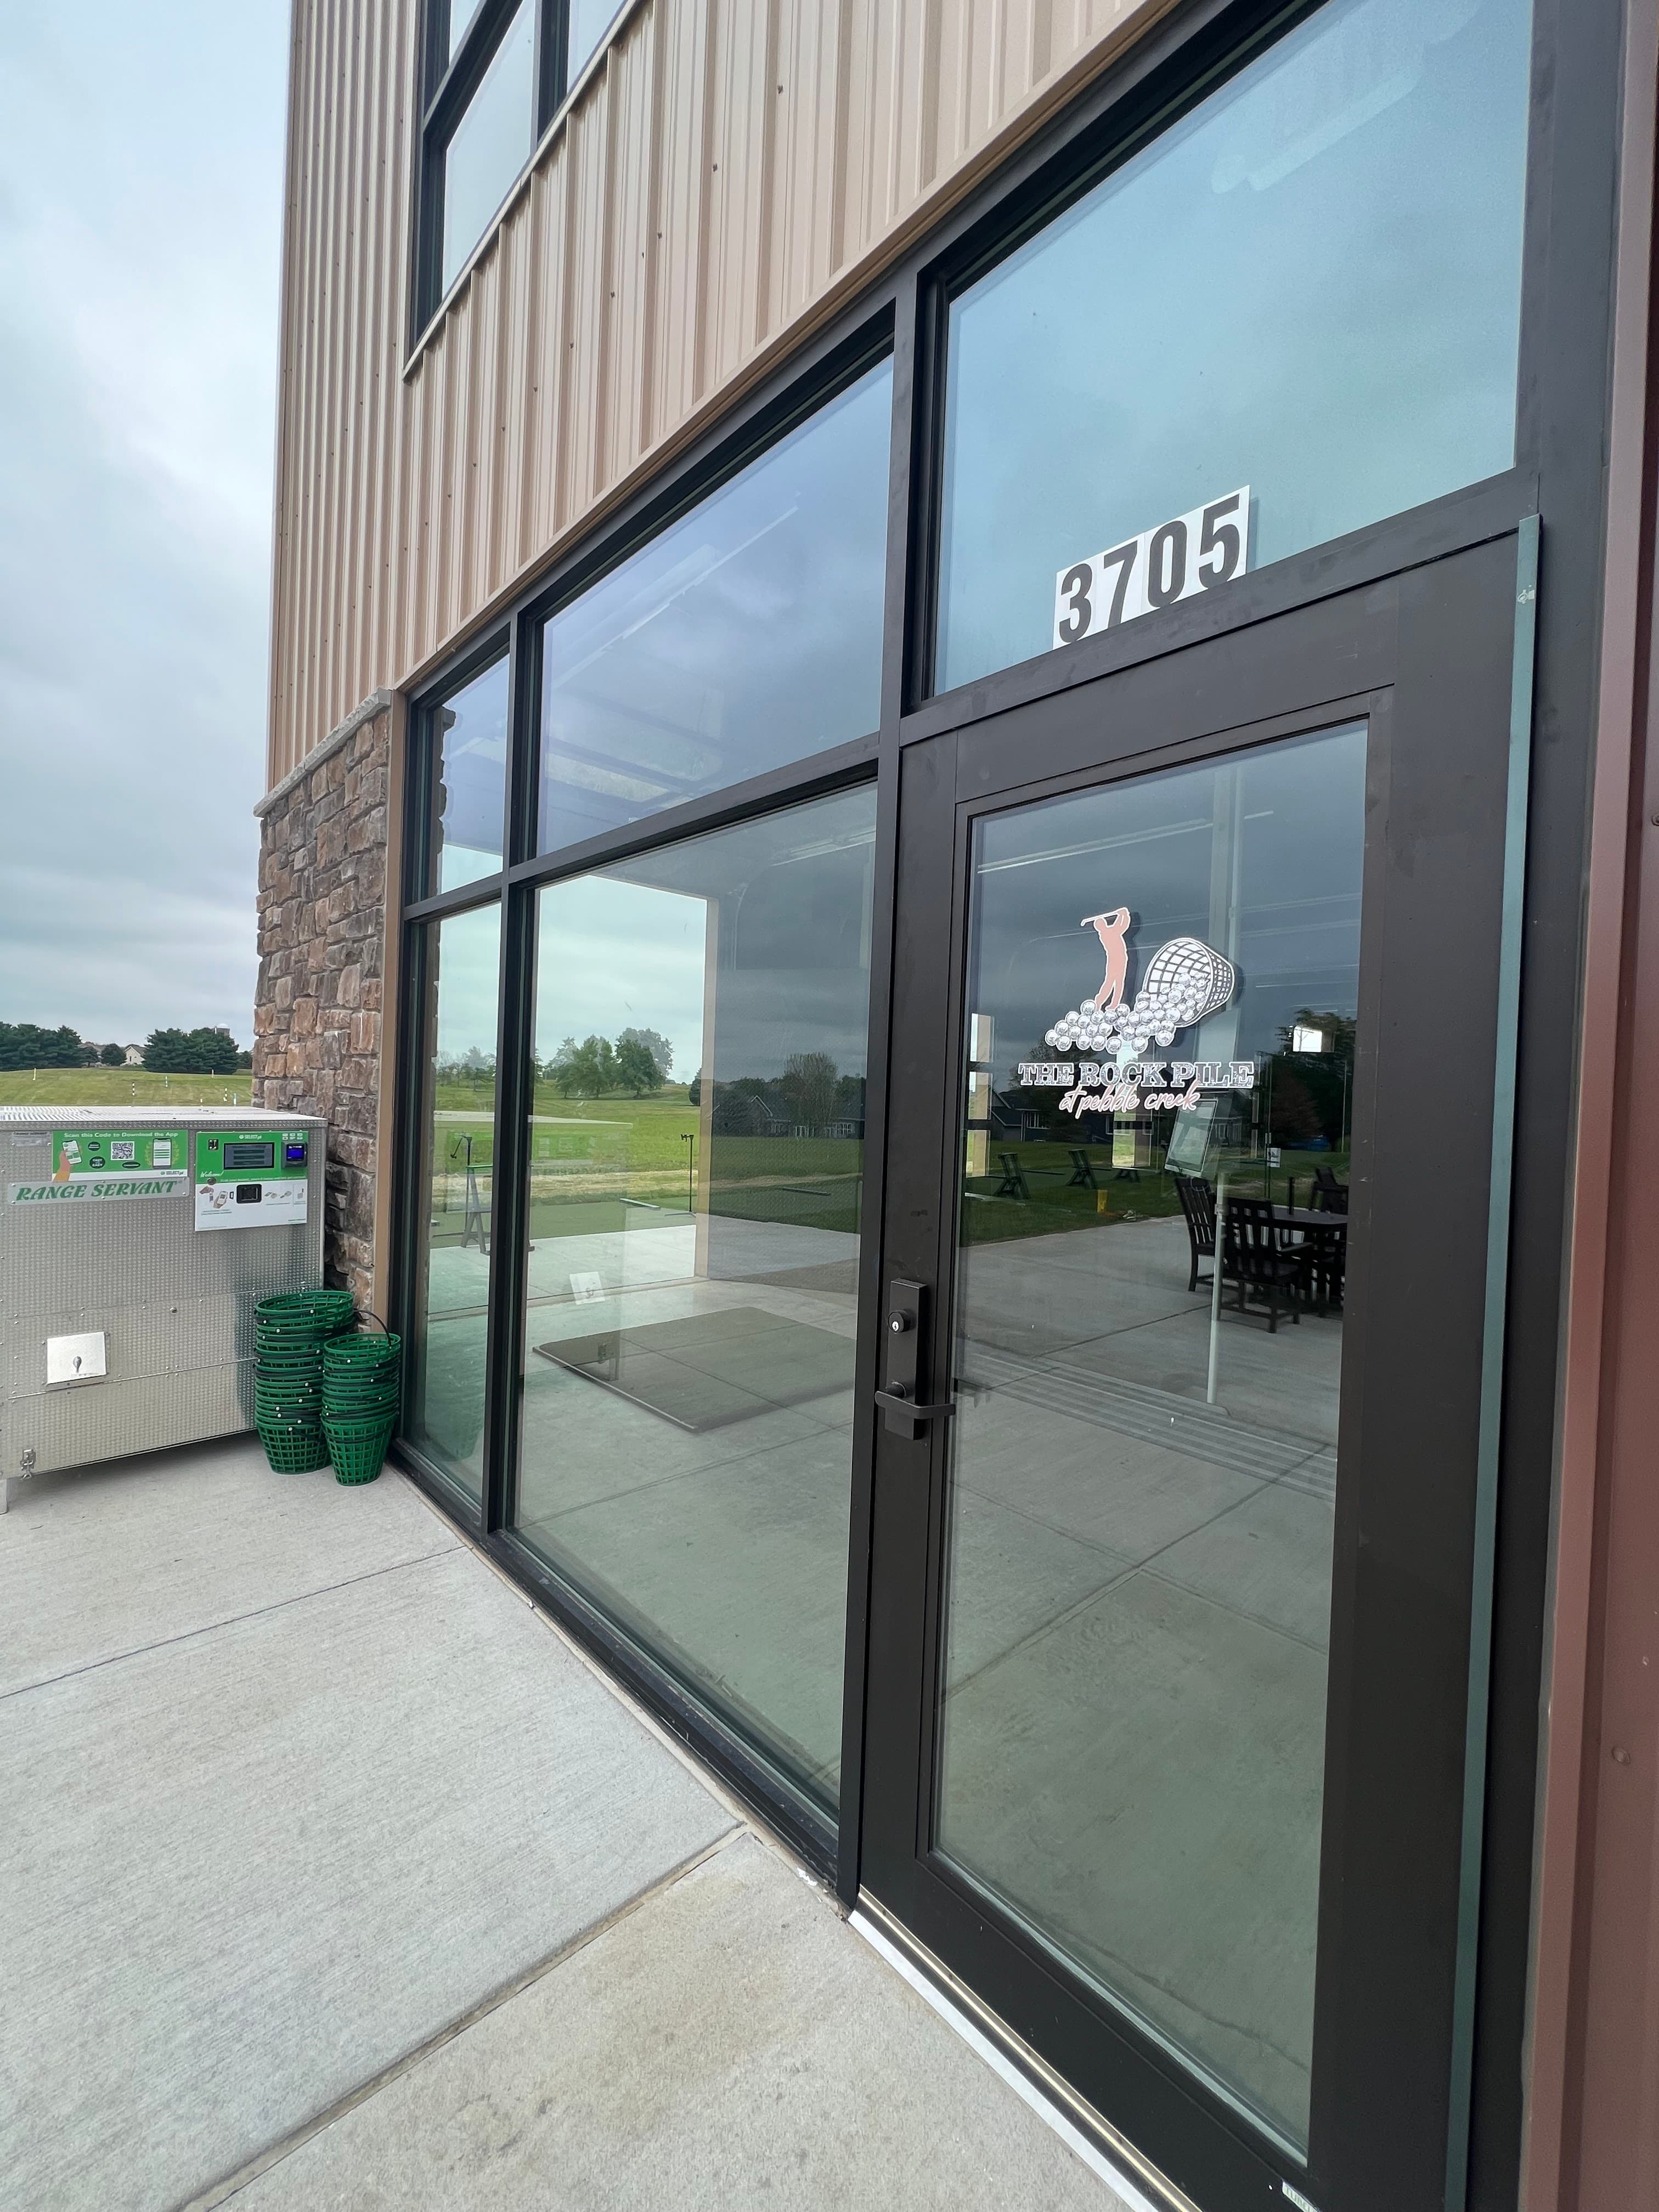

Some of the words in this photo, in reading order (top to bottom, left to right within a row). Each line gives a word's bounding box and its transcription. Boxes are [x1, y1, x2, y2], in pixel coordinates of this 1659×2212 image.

[1059, 493, 1240, 644] 3705
[1018, 1062, 1074, 1087] THE
[1079, 1062, 1169, 1087] ROCK
[1170, 1062, 1255, 1089] PILE
[1059, 1086, 1084, 1113] at
[1075, 1083, 1139, 1119] pebble
[1144, 1080, 1201, 1110] creek
[15, 1184, 87, 1201] RANGE
[91, 1181, 178, 1198] SERVANT
[1285, 2185, 1316, 2212] TUBEL
